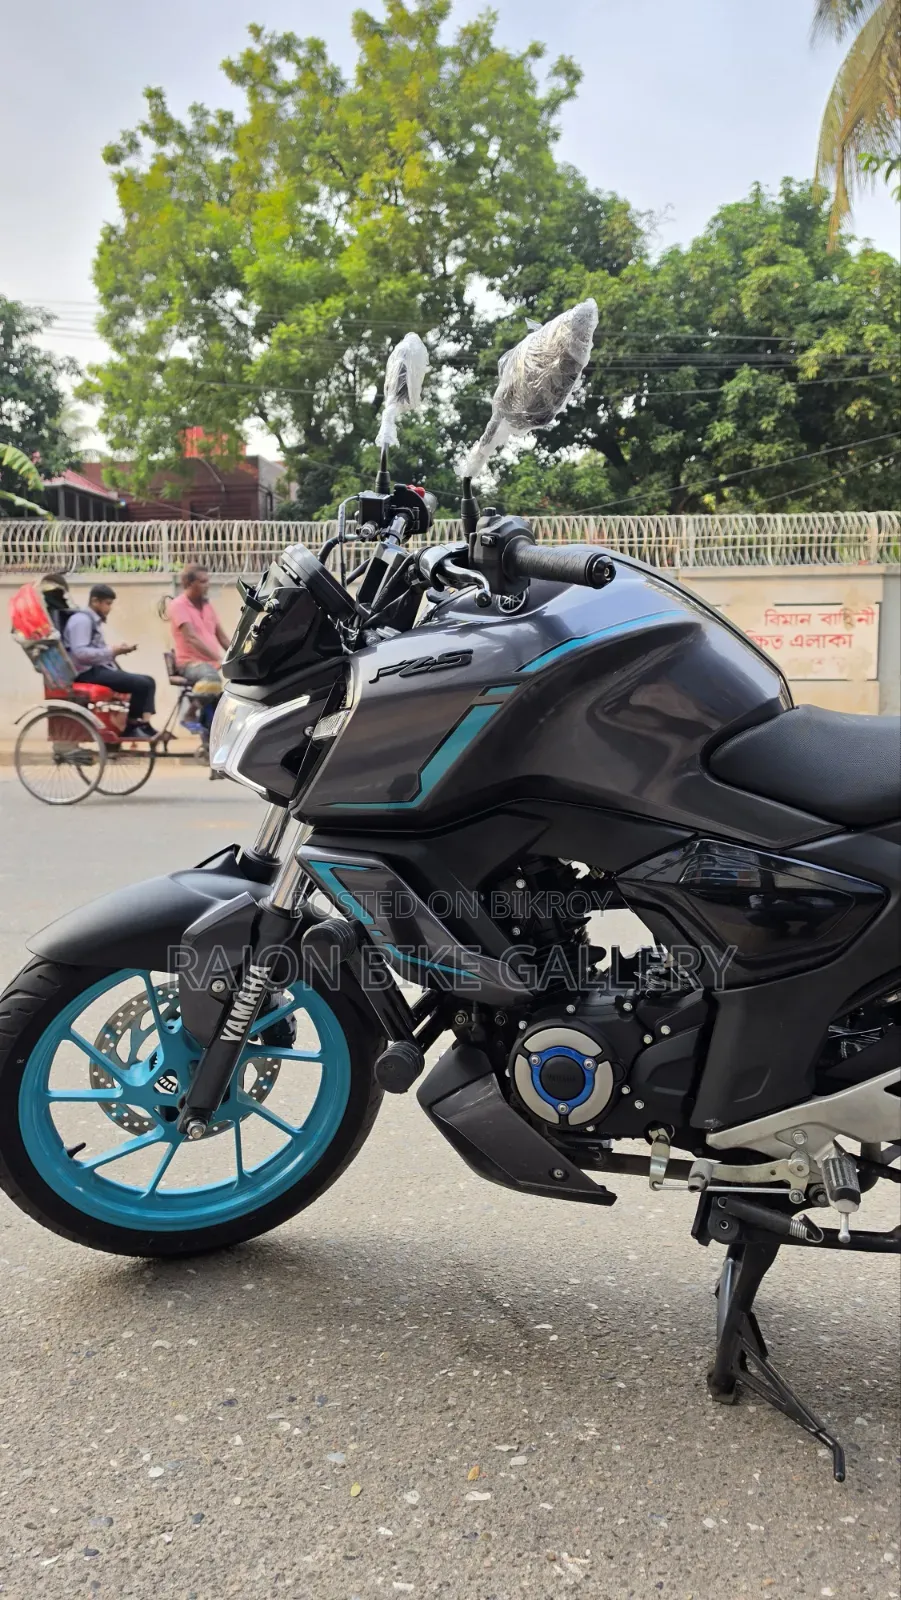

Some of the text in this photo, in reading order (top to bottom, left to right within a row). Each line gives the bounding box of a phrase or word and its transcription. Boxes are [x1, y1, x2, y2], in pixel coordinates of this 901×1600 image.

[764, 609, 812, 627] বিমান
[789, 633, 854, 649] এলাকা
[220, 964, 272, 1042] YAMAHA
